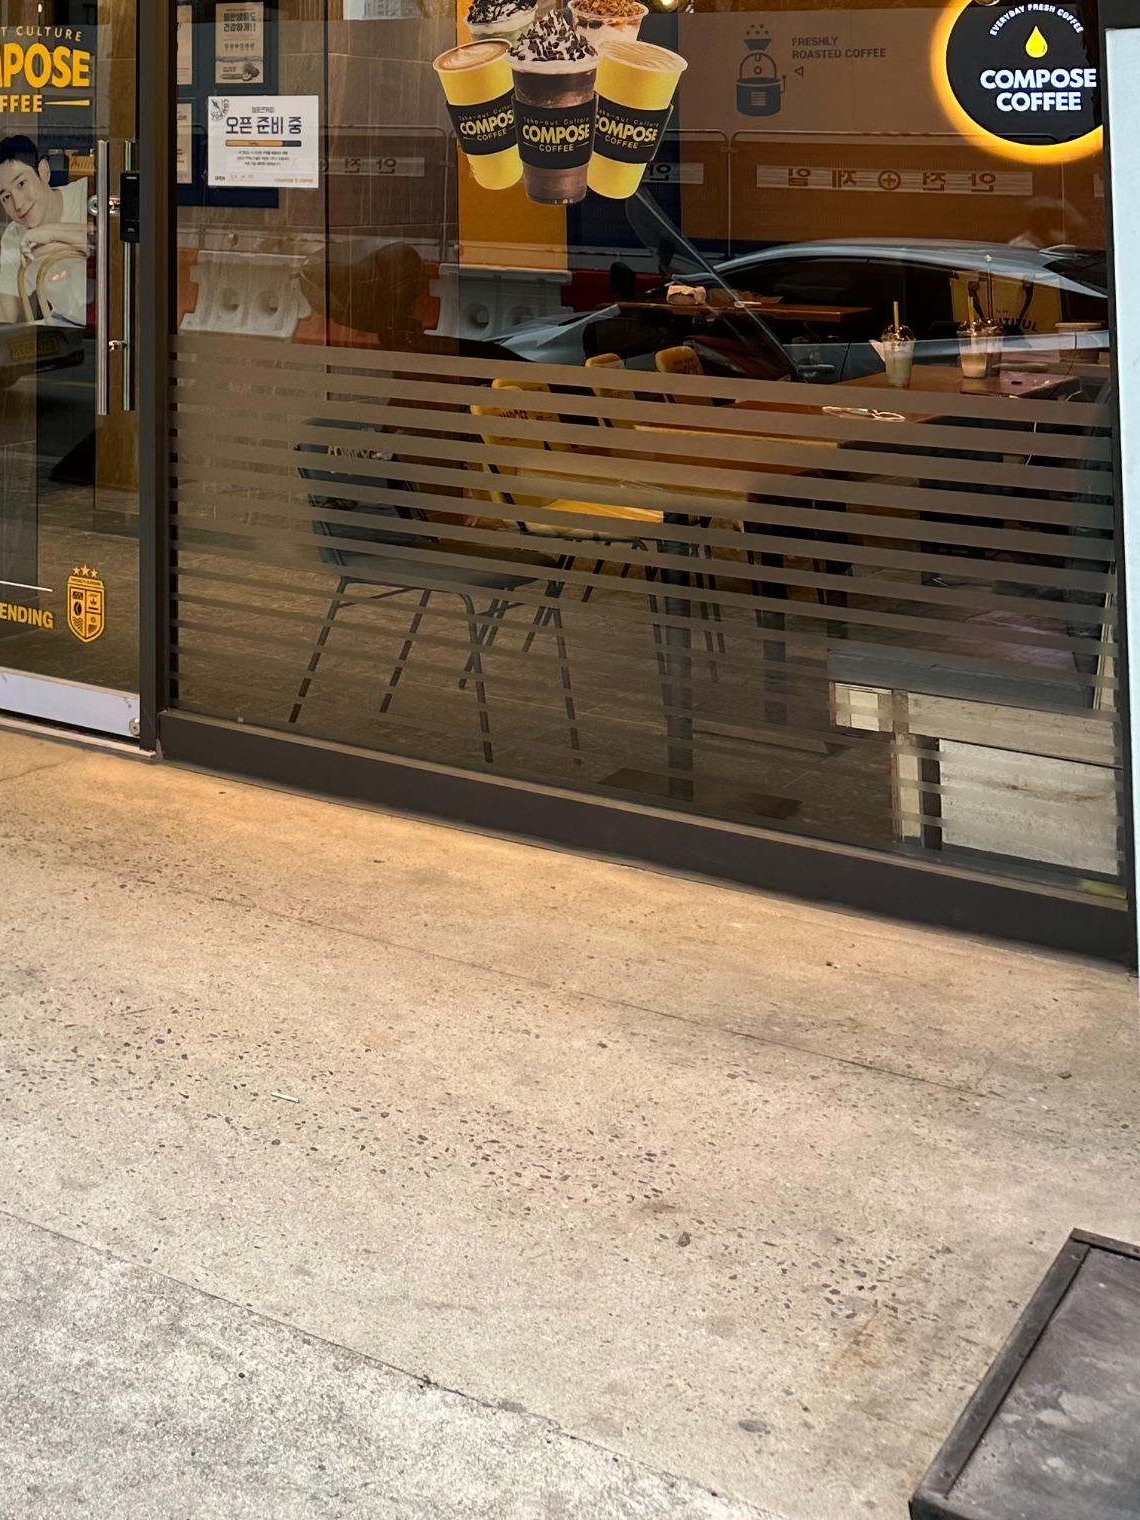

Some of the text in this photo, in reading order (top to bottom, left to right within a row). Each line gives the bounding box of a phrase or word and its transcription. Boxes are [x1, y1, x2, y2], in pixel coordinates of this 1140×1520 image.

[989, 3, 1084, 36] EVERYDAY FRESH COFFEE
[16, 25, 82, 42] CULTURE
[792, 36, 838, 46] FRESHLY
[792, 48, 886, 59] ROASTED COFFEE
[980, 68, 1097, 89] COMPOSE
[996, 92, 1082, 112] COFFEE
[226, 116, 302, 134] 오픈 준비 중
[522, 123, 590, 144] COMPOSE
[477, 127, 507, 141] COFFEE
[604, 135, 639, 149] COFFEE
[539, 144, 574, 152] COFFEE
